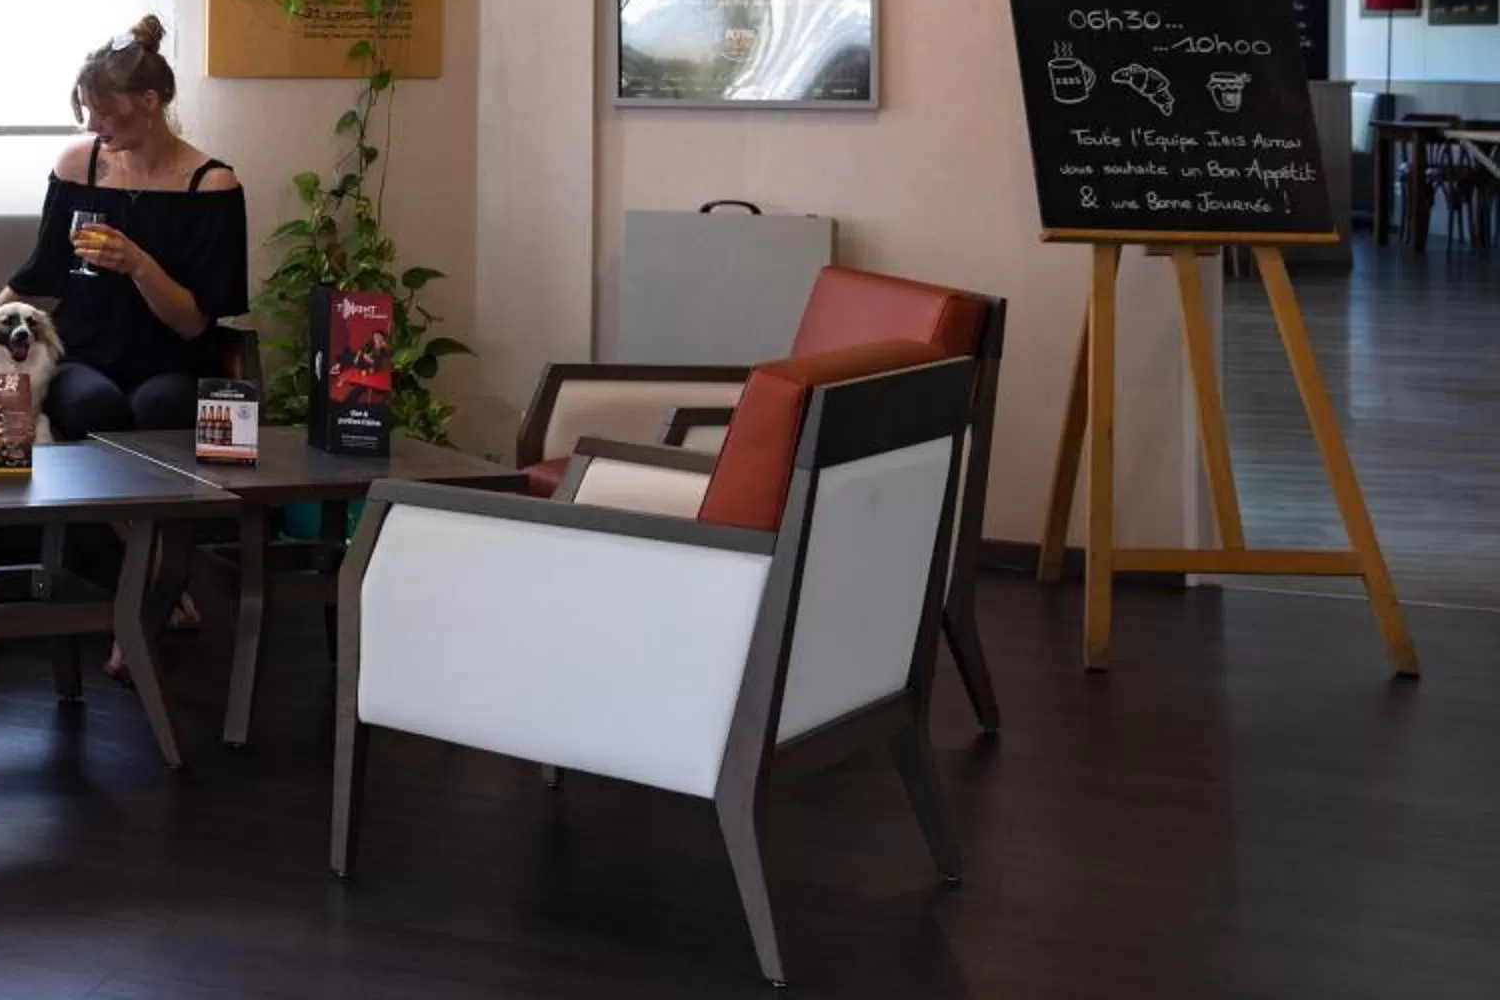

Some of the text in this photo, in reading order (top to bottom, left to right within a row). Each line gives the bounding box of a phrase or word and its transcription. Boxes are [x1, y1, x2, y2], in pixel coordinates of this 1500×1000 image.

[1103, 159, 1169, 177] souhaite
[1181, 166, 1201, 178] un
[1207, 160, 1241, 178] Bon
